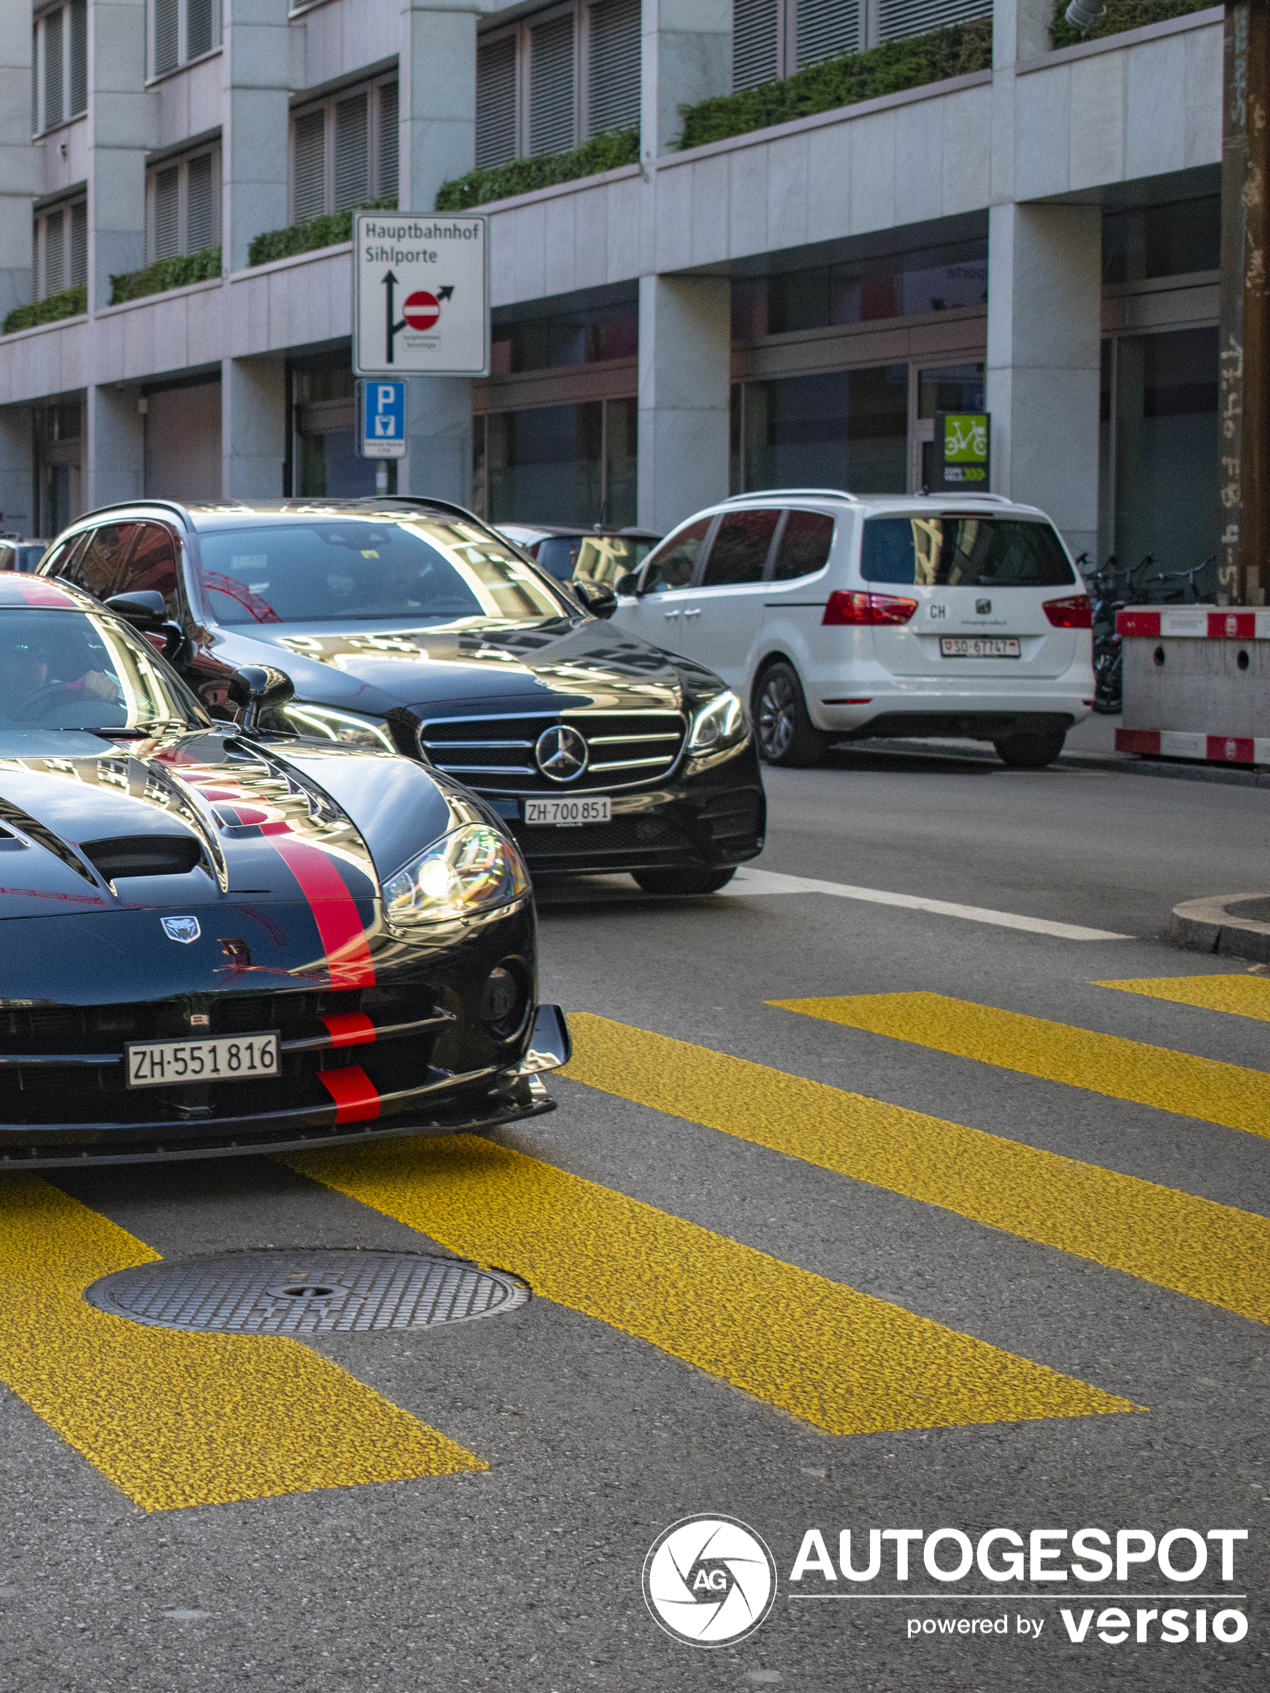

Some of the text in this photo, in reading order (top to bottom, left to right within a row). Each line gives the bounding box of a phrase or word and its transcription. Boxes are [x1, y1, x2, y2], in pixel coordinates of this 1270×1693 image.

[365, 222, 479, 242] Hauptbahnhof
[365, 246, 438, 265] Sihlporte
[377, 385, 396, 414] P
[930, 604, 946, 619] CH
